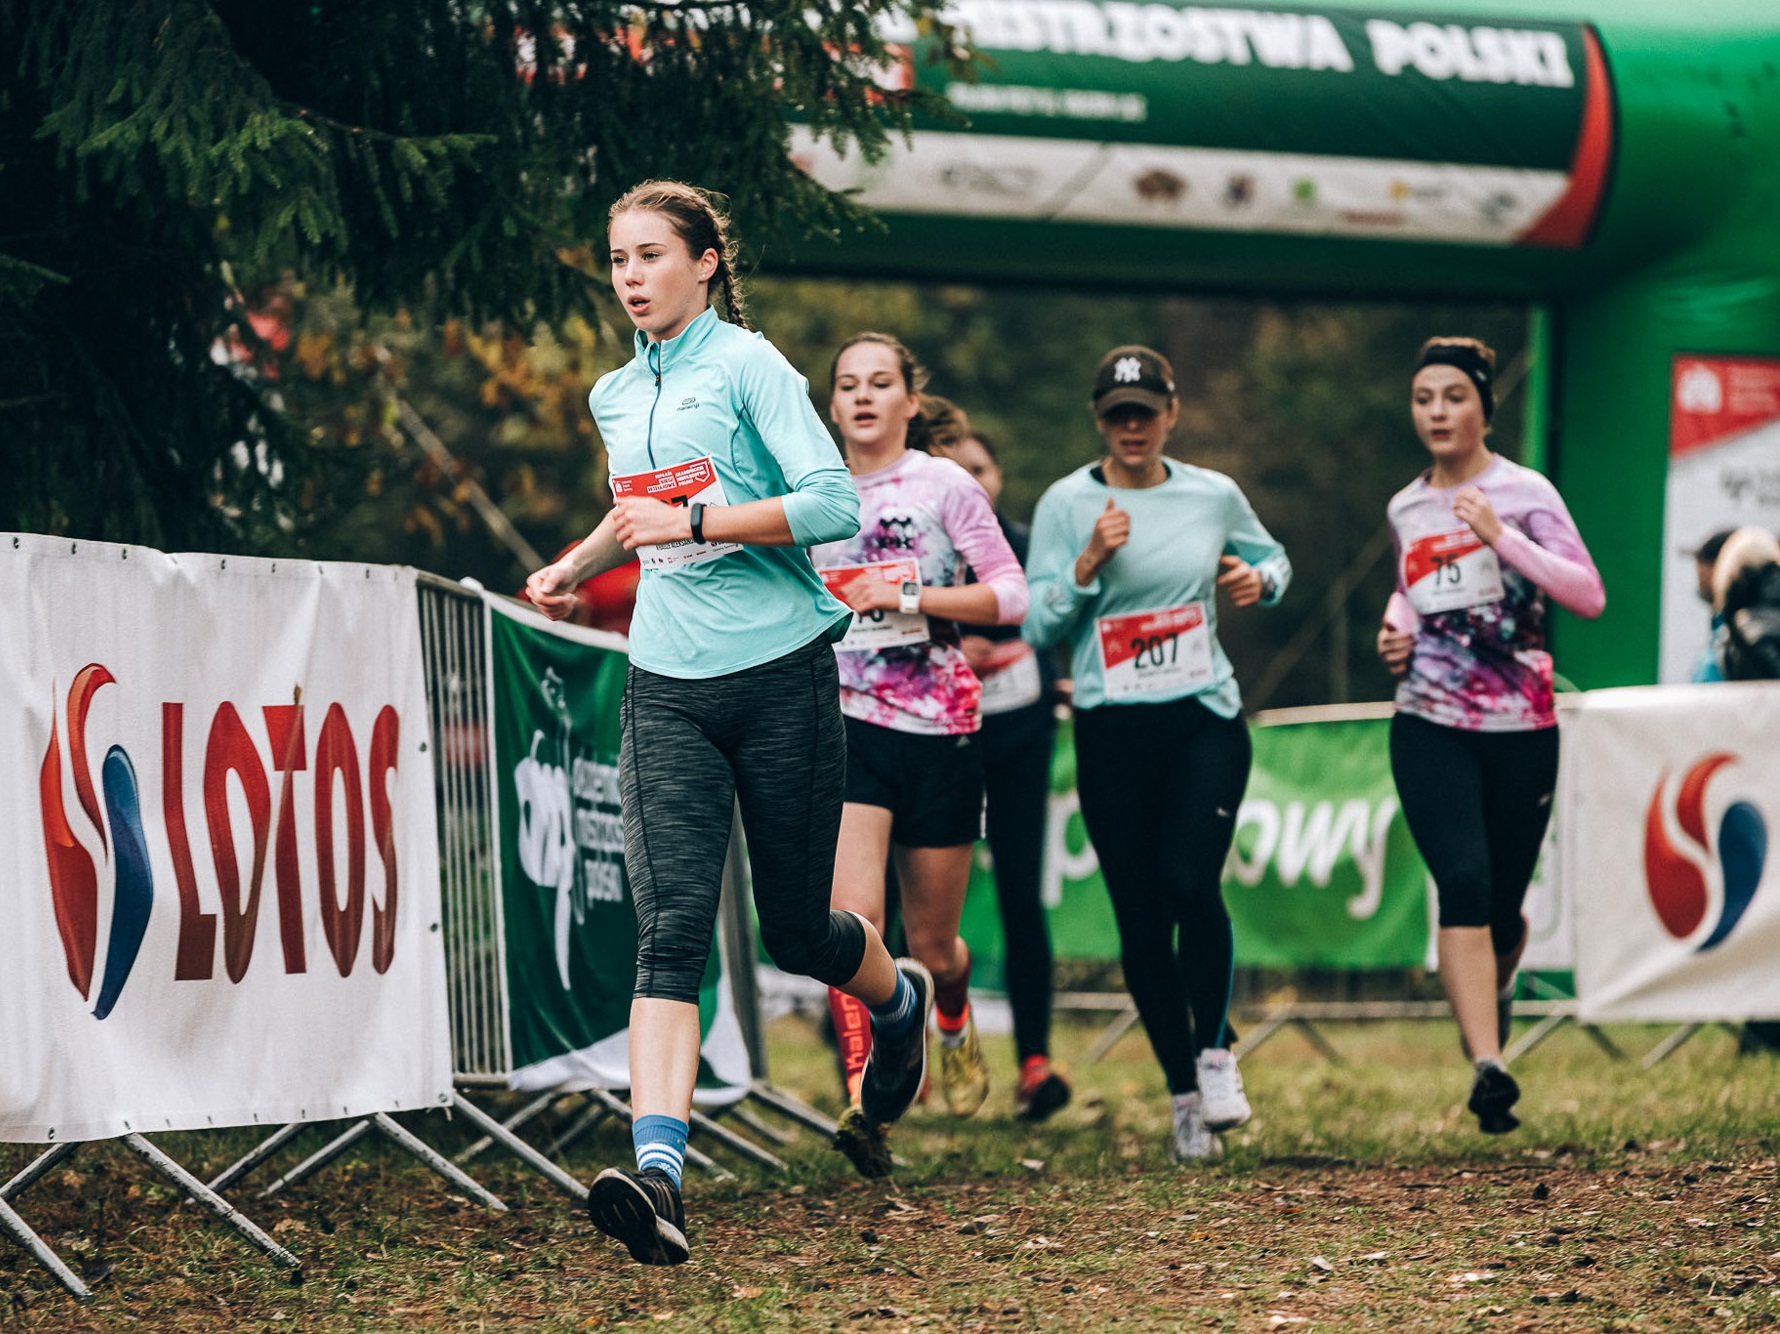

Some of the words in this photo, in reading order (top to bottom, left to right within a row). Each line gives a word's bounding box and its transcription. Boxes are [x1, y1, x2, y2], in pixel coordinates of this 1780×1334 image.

[1365, 18, 1574, 88] POLSKI
[1430, 553, 1462, 586] 75
[1130, 632, 1179, 669] 207
[162, 701, 399, 985] LOTOS
